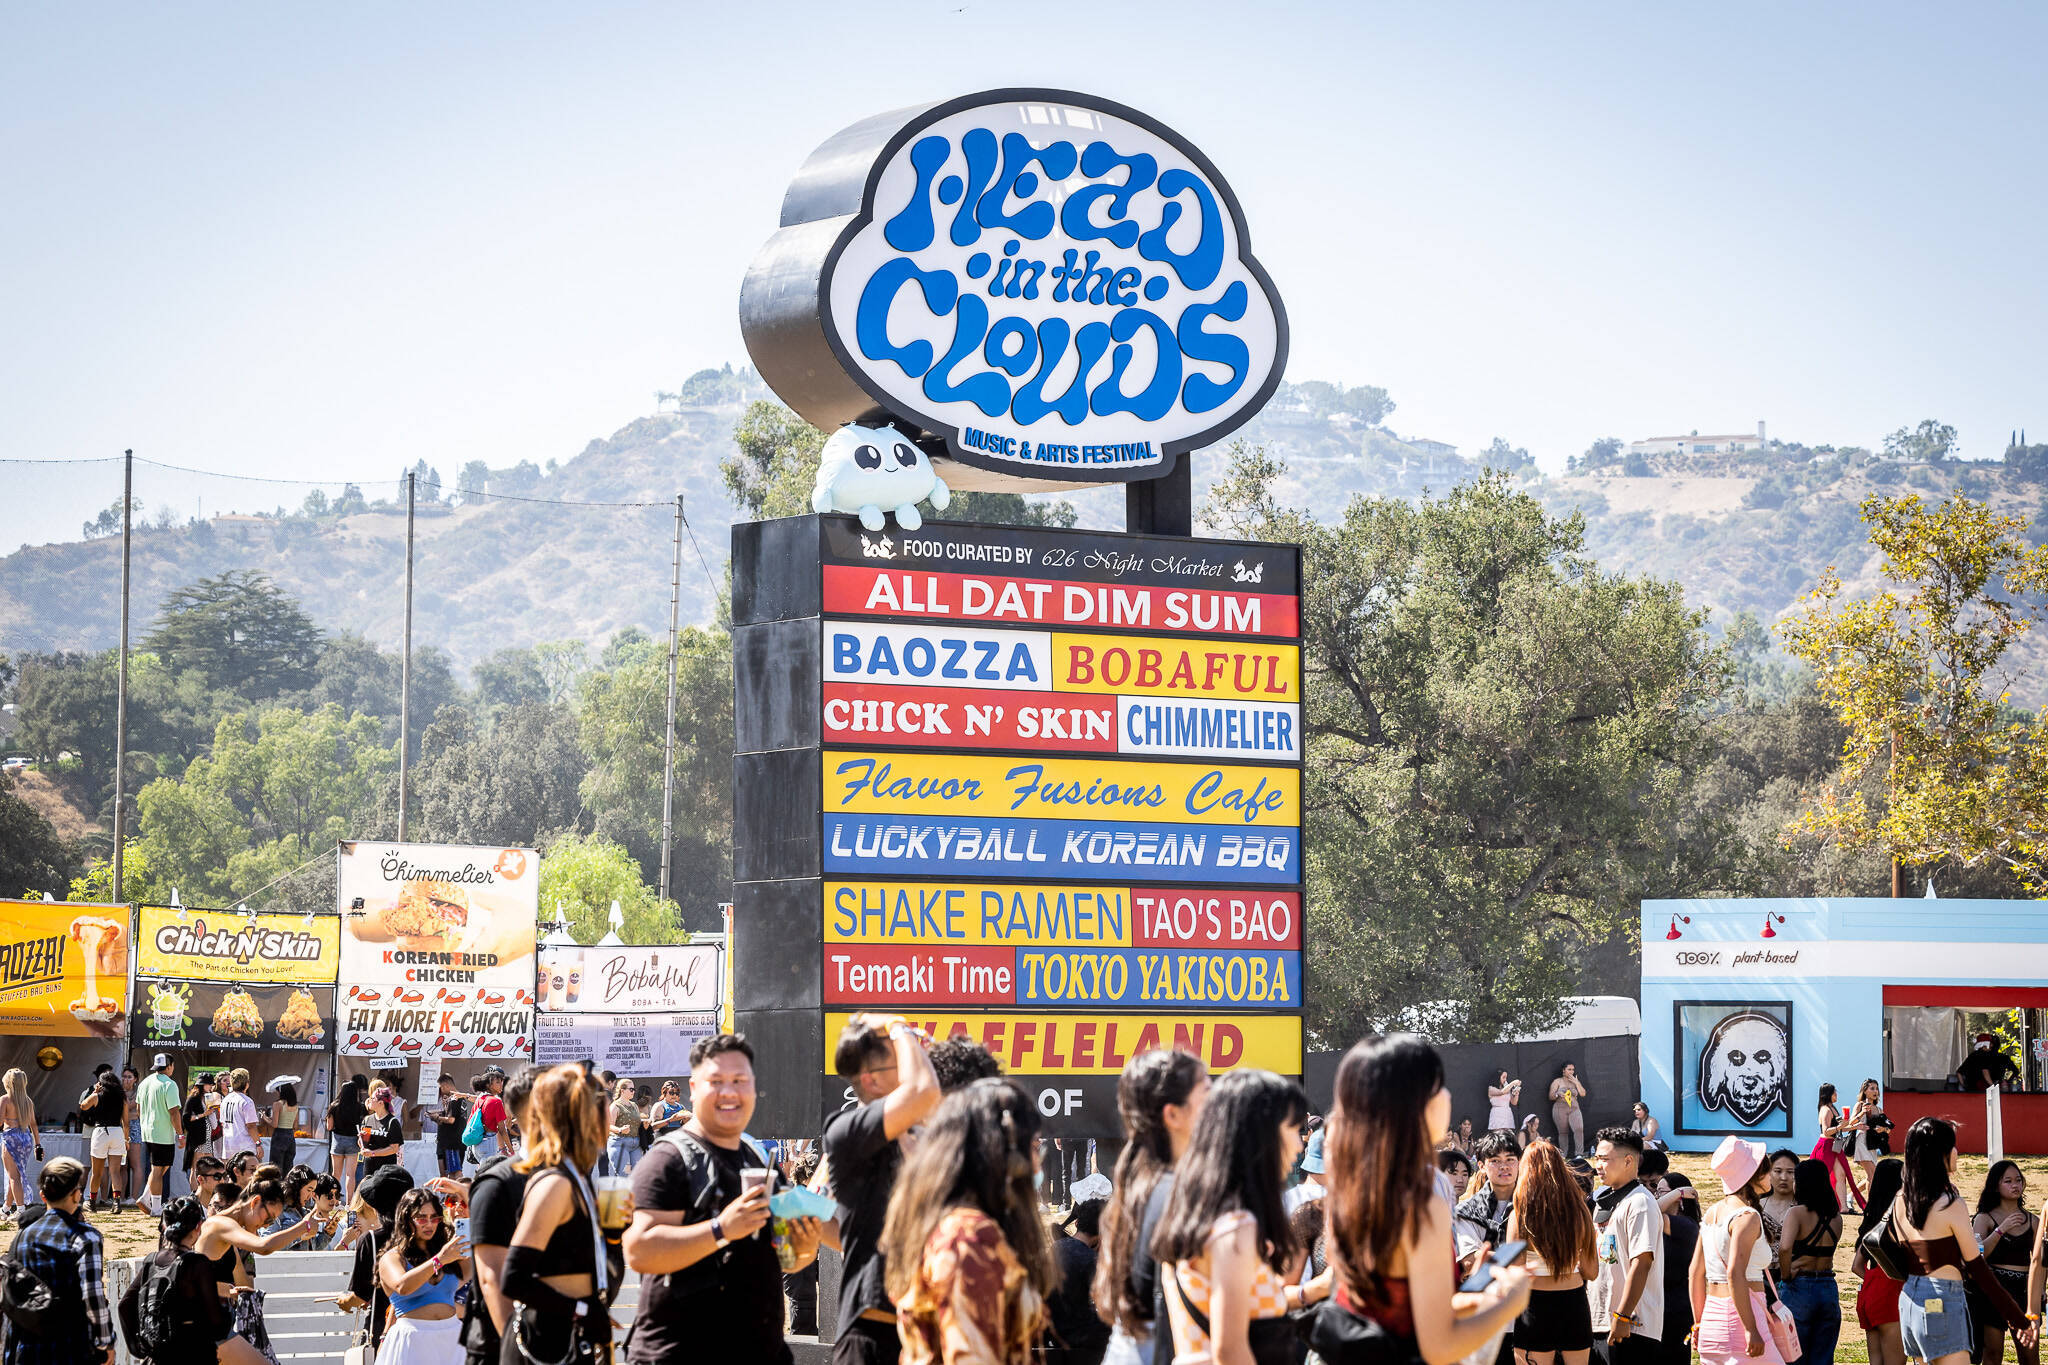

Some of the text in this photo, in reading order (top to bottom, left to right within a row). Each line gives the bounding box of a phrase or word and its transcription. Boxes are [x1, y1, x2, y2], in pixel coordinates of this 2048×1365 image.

[988, 239, 1141, 307] in the
[965, 427, 1158, 464] MUSIC & ARTS FESTIVAL
[903, 540, 1225, 577] FOOD CURATED BY 626 Night Market
[864, 573, 1262, 632] ALL DAT DIM SUM
[832, 633, 1039, 683] BAOZZA
[1066, 645, 1288, 694] BOBAFUL
[823, 698, 952, 736] CHICK
[1016, 706, 1112, 742] SKIN
[1126, 704, 1294, 752] CHIMMELIER
[836, 758, 1285, 824] Flavor Fusions Cafe
[831, 823, 1291, 872] LUCKYBALL KOREAN BBQ
[381, 857, 495, 884] Chimmelier
[834, 886, 1123, 941] SHAKE RAMEN
[1137, 897, 1292, 942] TAO'S BAO
[0, 935, 66, 984] AOZZA!
[190, 960, 203, 969] The
[206, 963, 220, 972] Part
[221, 965, 229, 973] of
[230, 966, 259, 974] Chicken
[383, 950, 499, 967] KOREAN FRIED
[405, 969, 475, 983] CHICKEN
[602, 955, 701, 1004] Bobaful
[831, 954, 1011, 996] Temaki Time
[1022, 952, 1290, 1002] TOKYO YAKISOBA
[1676, 950, 1799, 968] 100% plant-based
[347, 1008, 529, 1035] EAT MORE K-CHICKEN
[538, 1017, 555, 1027] FRUIT
[557, 1017, 568, 1027] TEA
[613, 1017, 628, 1027] MILK
[630, 1017, 640, 1027] TEA
[632, 999, 652, 1007] BOBA
[672, 1016, 699, 1026] TOPPINGS
[1038, 1088, 1083, 1117] OF
